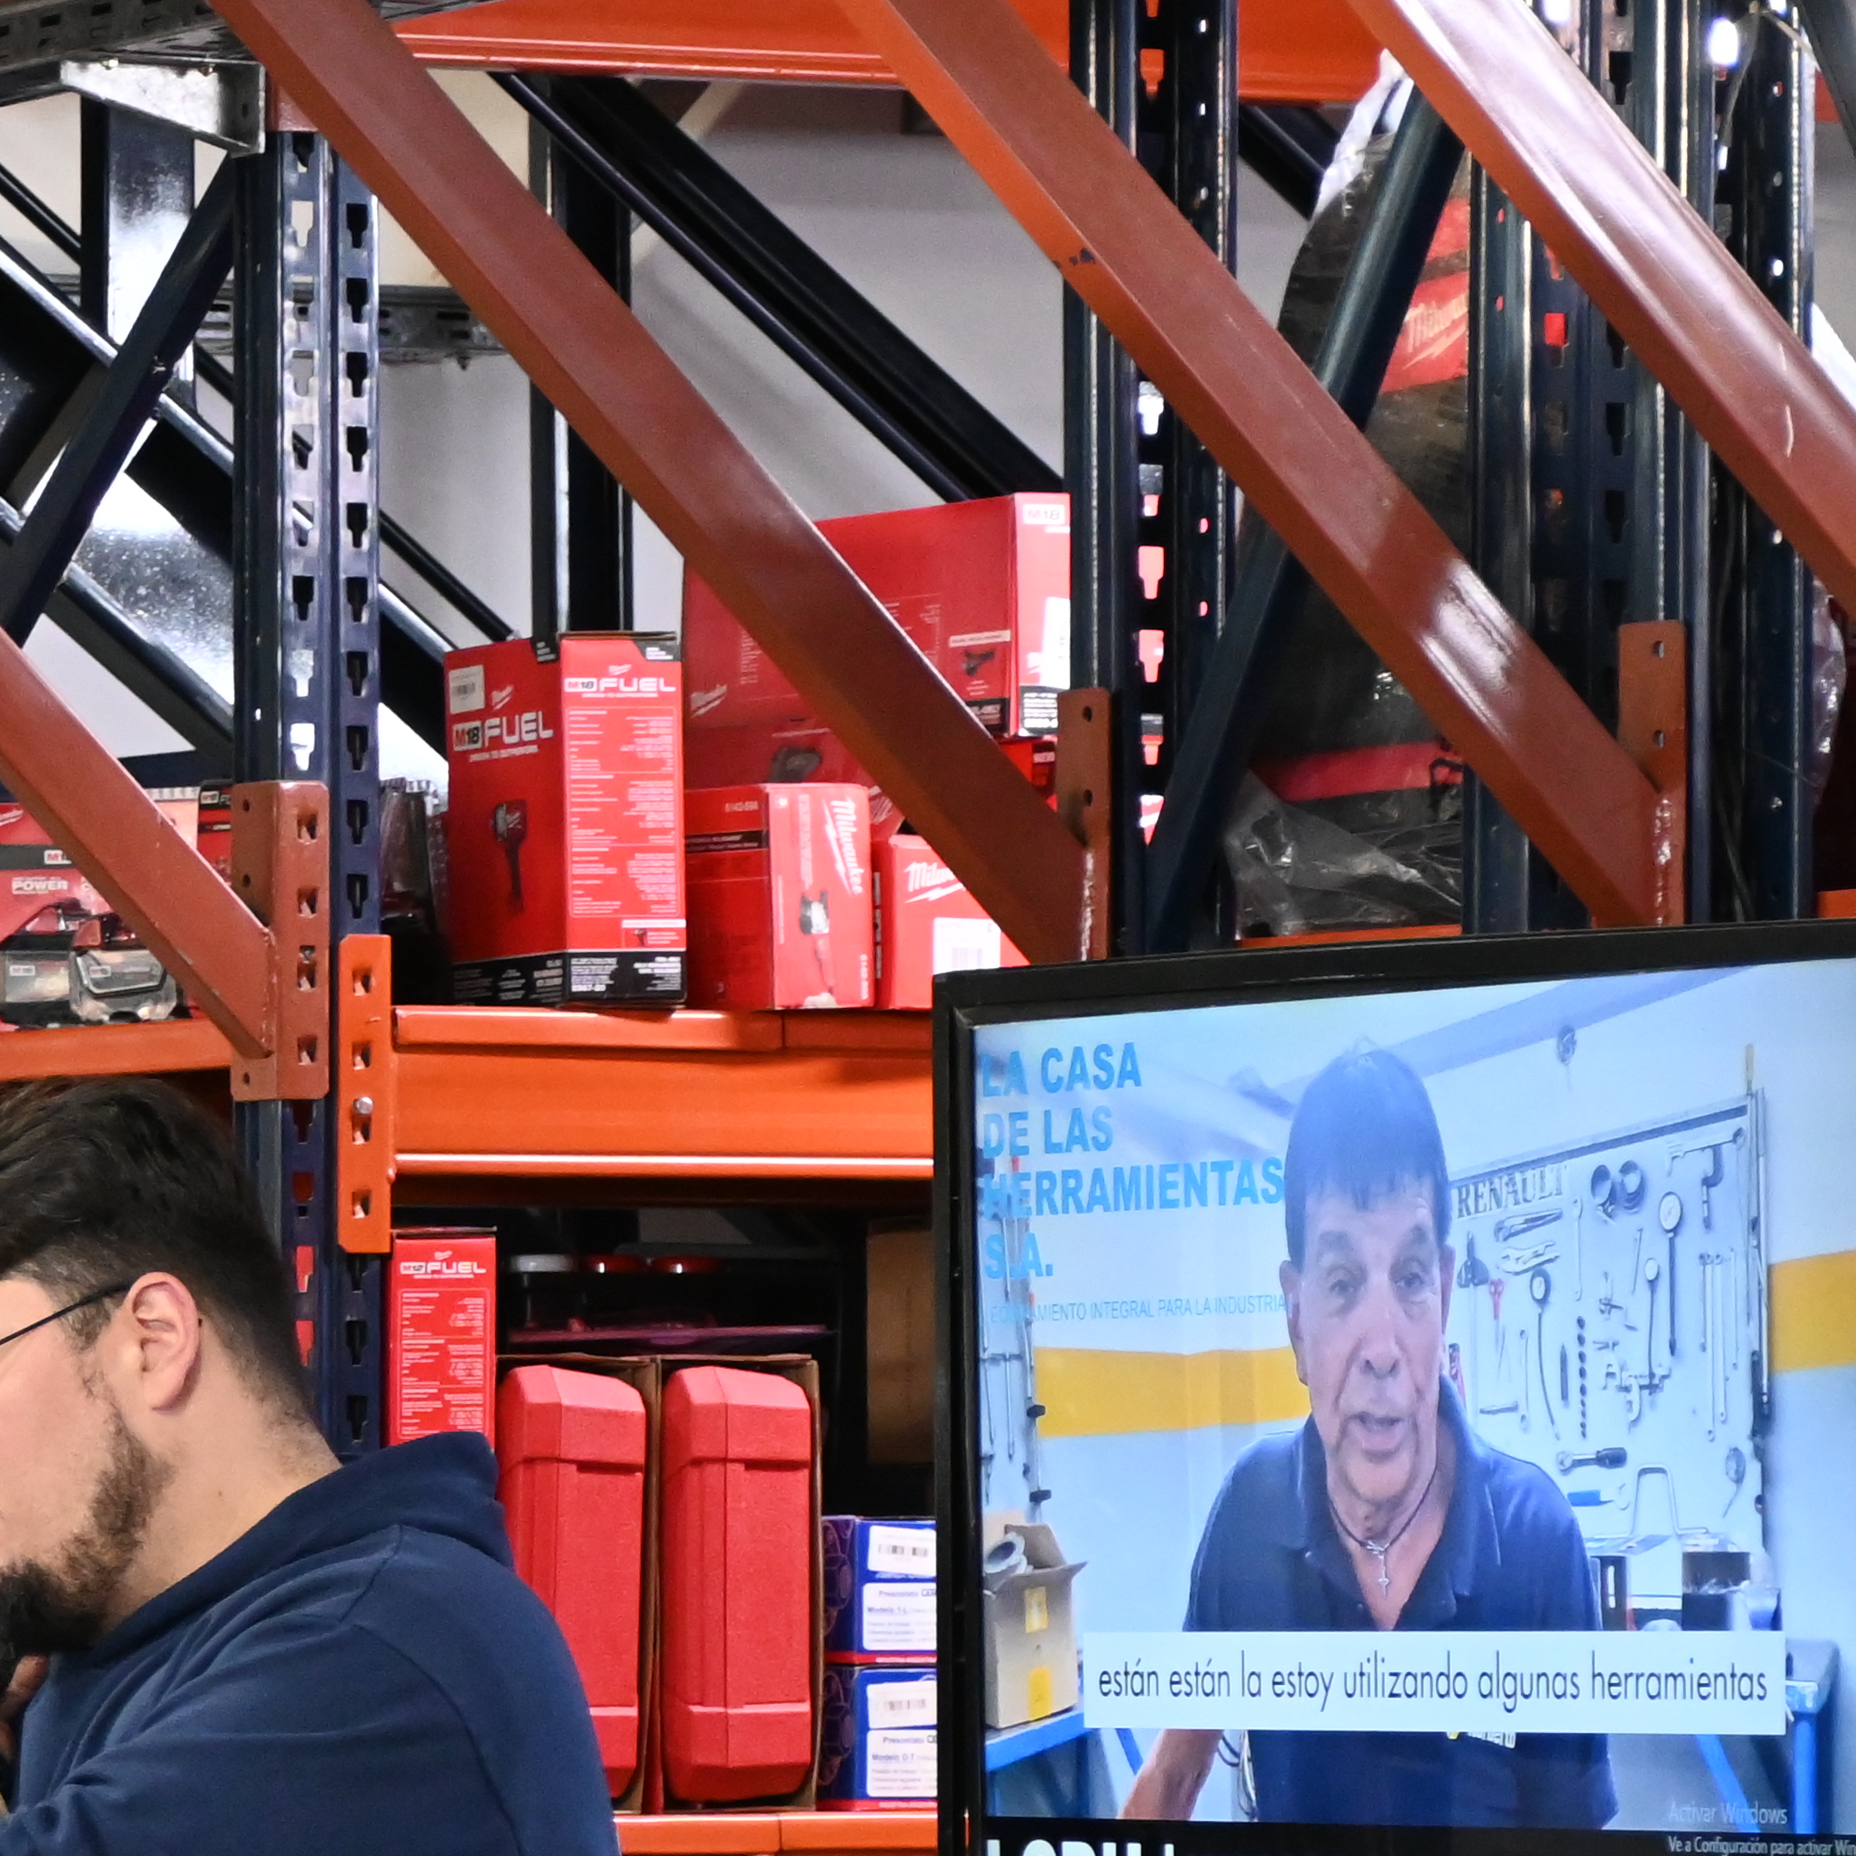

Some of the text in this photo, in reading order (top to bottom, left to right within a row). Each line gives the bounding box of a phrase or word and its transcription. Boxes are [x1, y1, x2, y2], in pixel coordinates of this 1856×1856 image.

[1027, 509, 1061, 521] M18
[600, 678, 676, 693] FUEL
[454, 710, 554, 748] M18 FUEL
[829, 796, 865, 896] Milwaukee
[12, 879, 69, 891] POWER
[981, 1042, 1142, 1098] LA CASA
[982, 1105, 1114, 1160] DE LAS
[980, 1156, 1286, 1219] HERRAMIENTAS
[1456, 1164, 1568, 1218] RENAULT
[427, 1261, 487, 1274] FUEL
[1089, 1300, 1155, 1320] INTEGRAL
[1158, 1298, 1192, 1318] PARA
[1195, 1297, 1212, 1316] LA
[1214, 1294, 1286, 1314] INDUSTRIA
[1099, 1649, 1768, 1714] están están la estoy utilizando algunas herramientas
[1668, 1800, 1789, 1824] Activar Windows
[1668, 1835, 1683, 1853] Ve
[1796, 1840, 1834, 1856] activar
